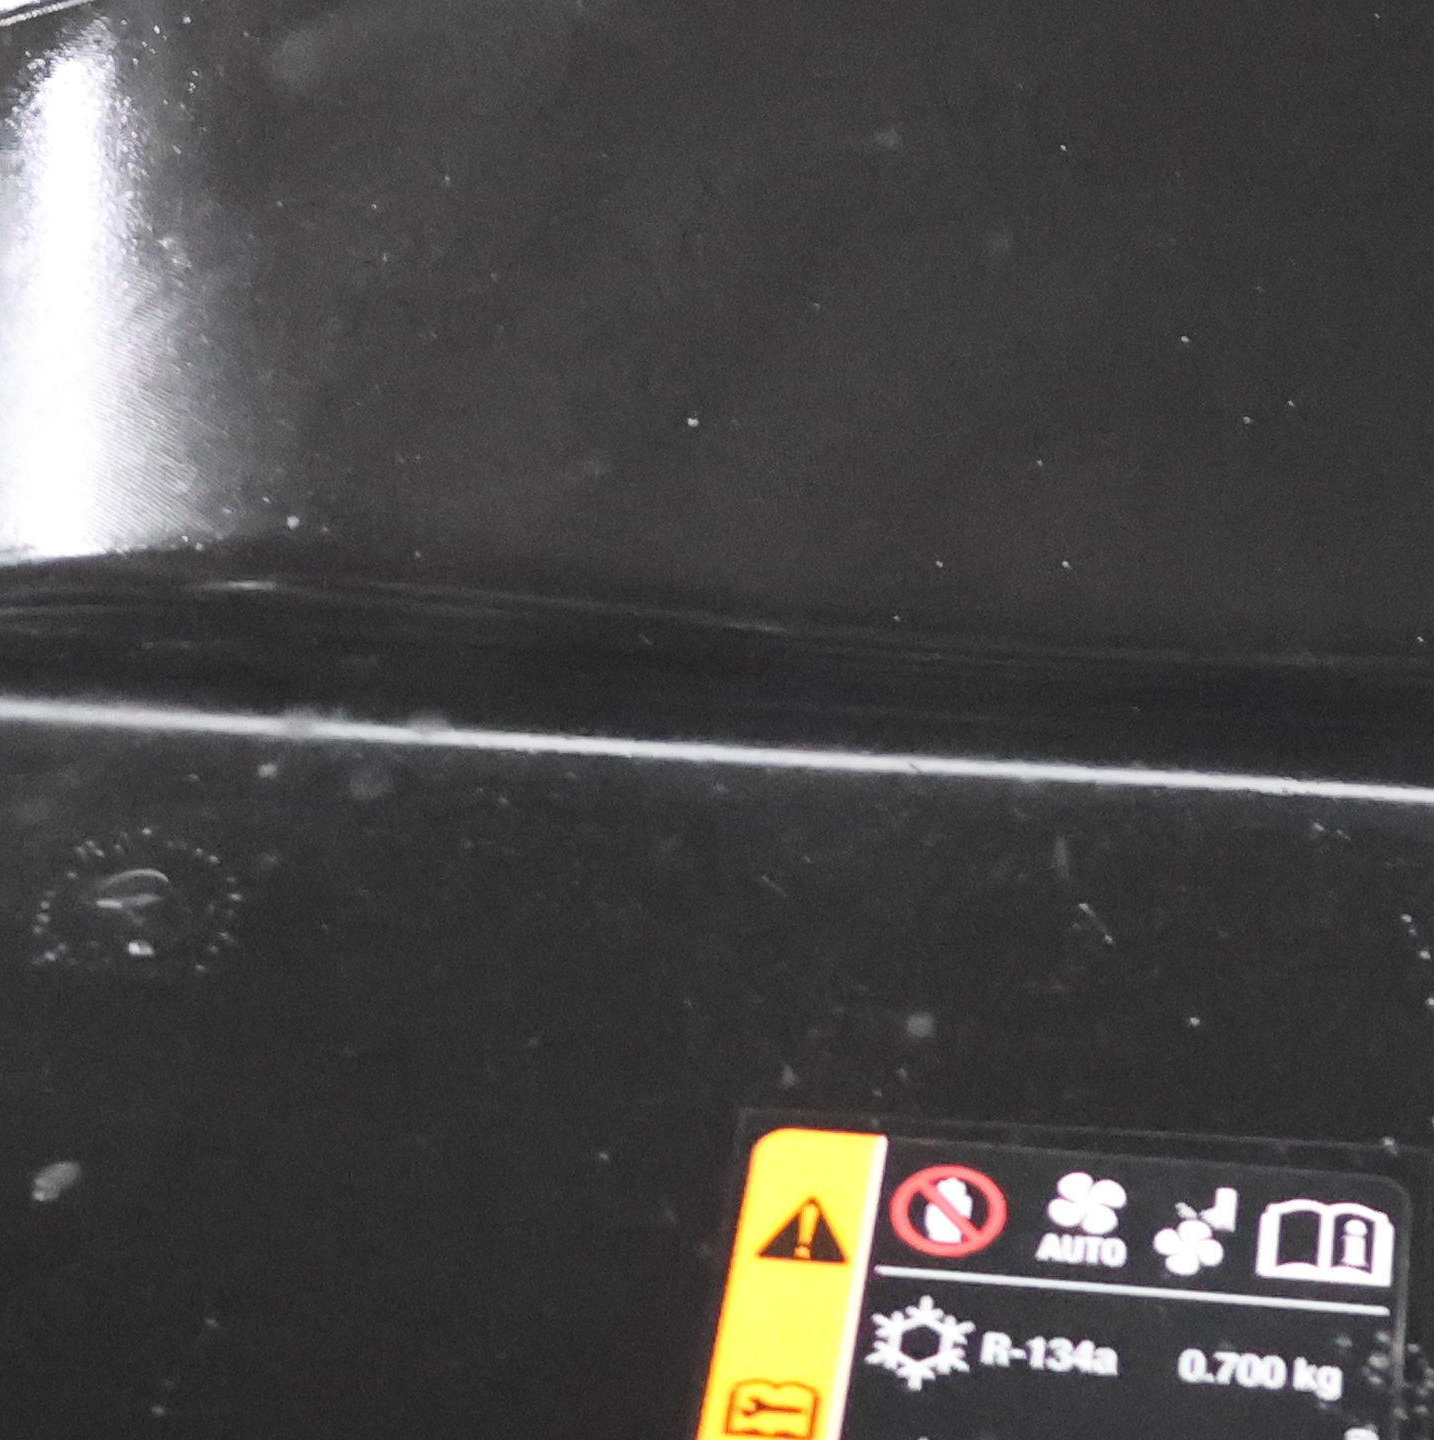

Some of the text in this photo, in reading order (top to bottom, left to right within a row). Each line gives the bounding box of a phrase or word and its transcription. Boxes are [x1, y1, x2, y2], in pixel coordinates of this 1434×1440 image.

[1034, 1233, 1127, 1268] AUTO
[980, 1331, 1343, 1402] R-134a 0.700 kg
